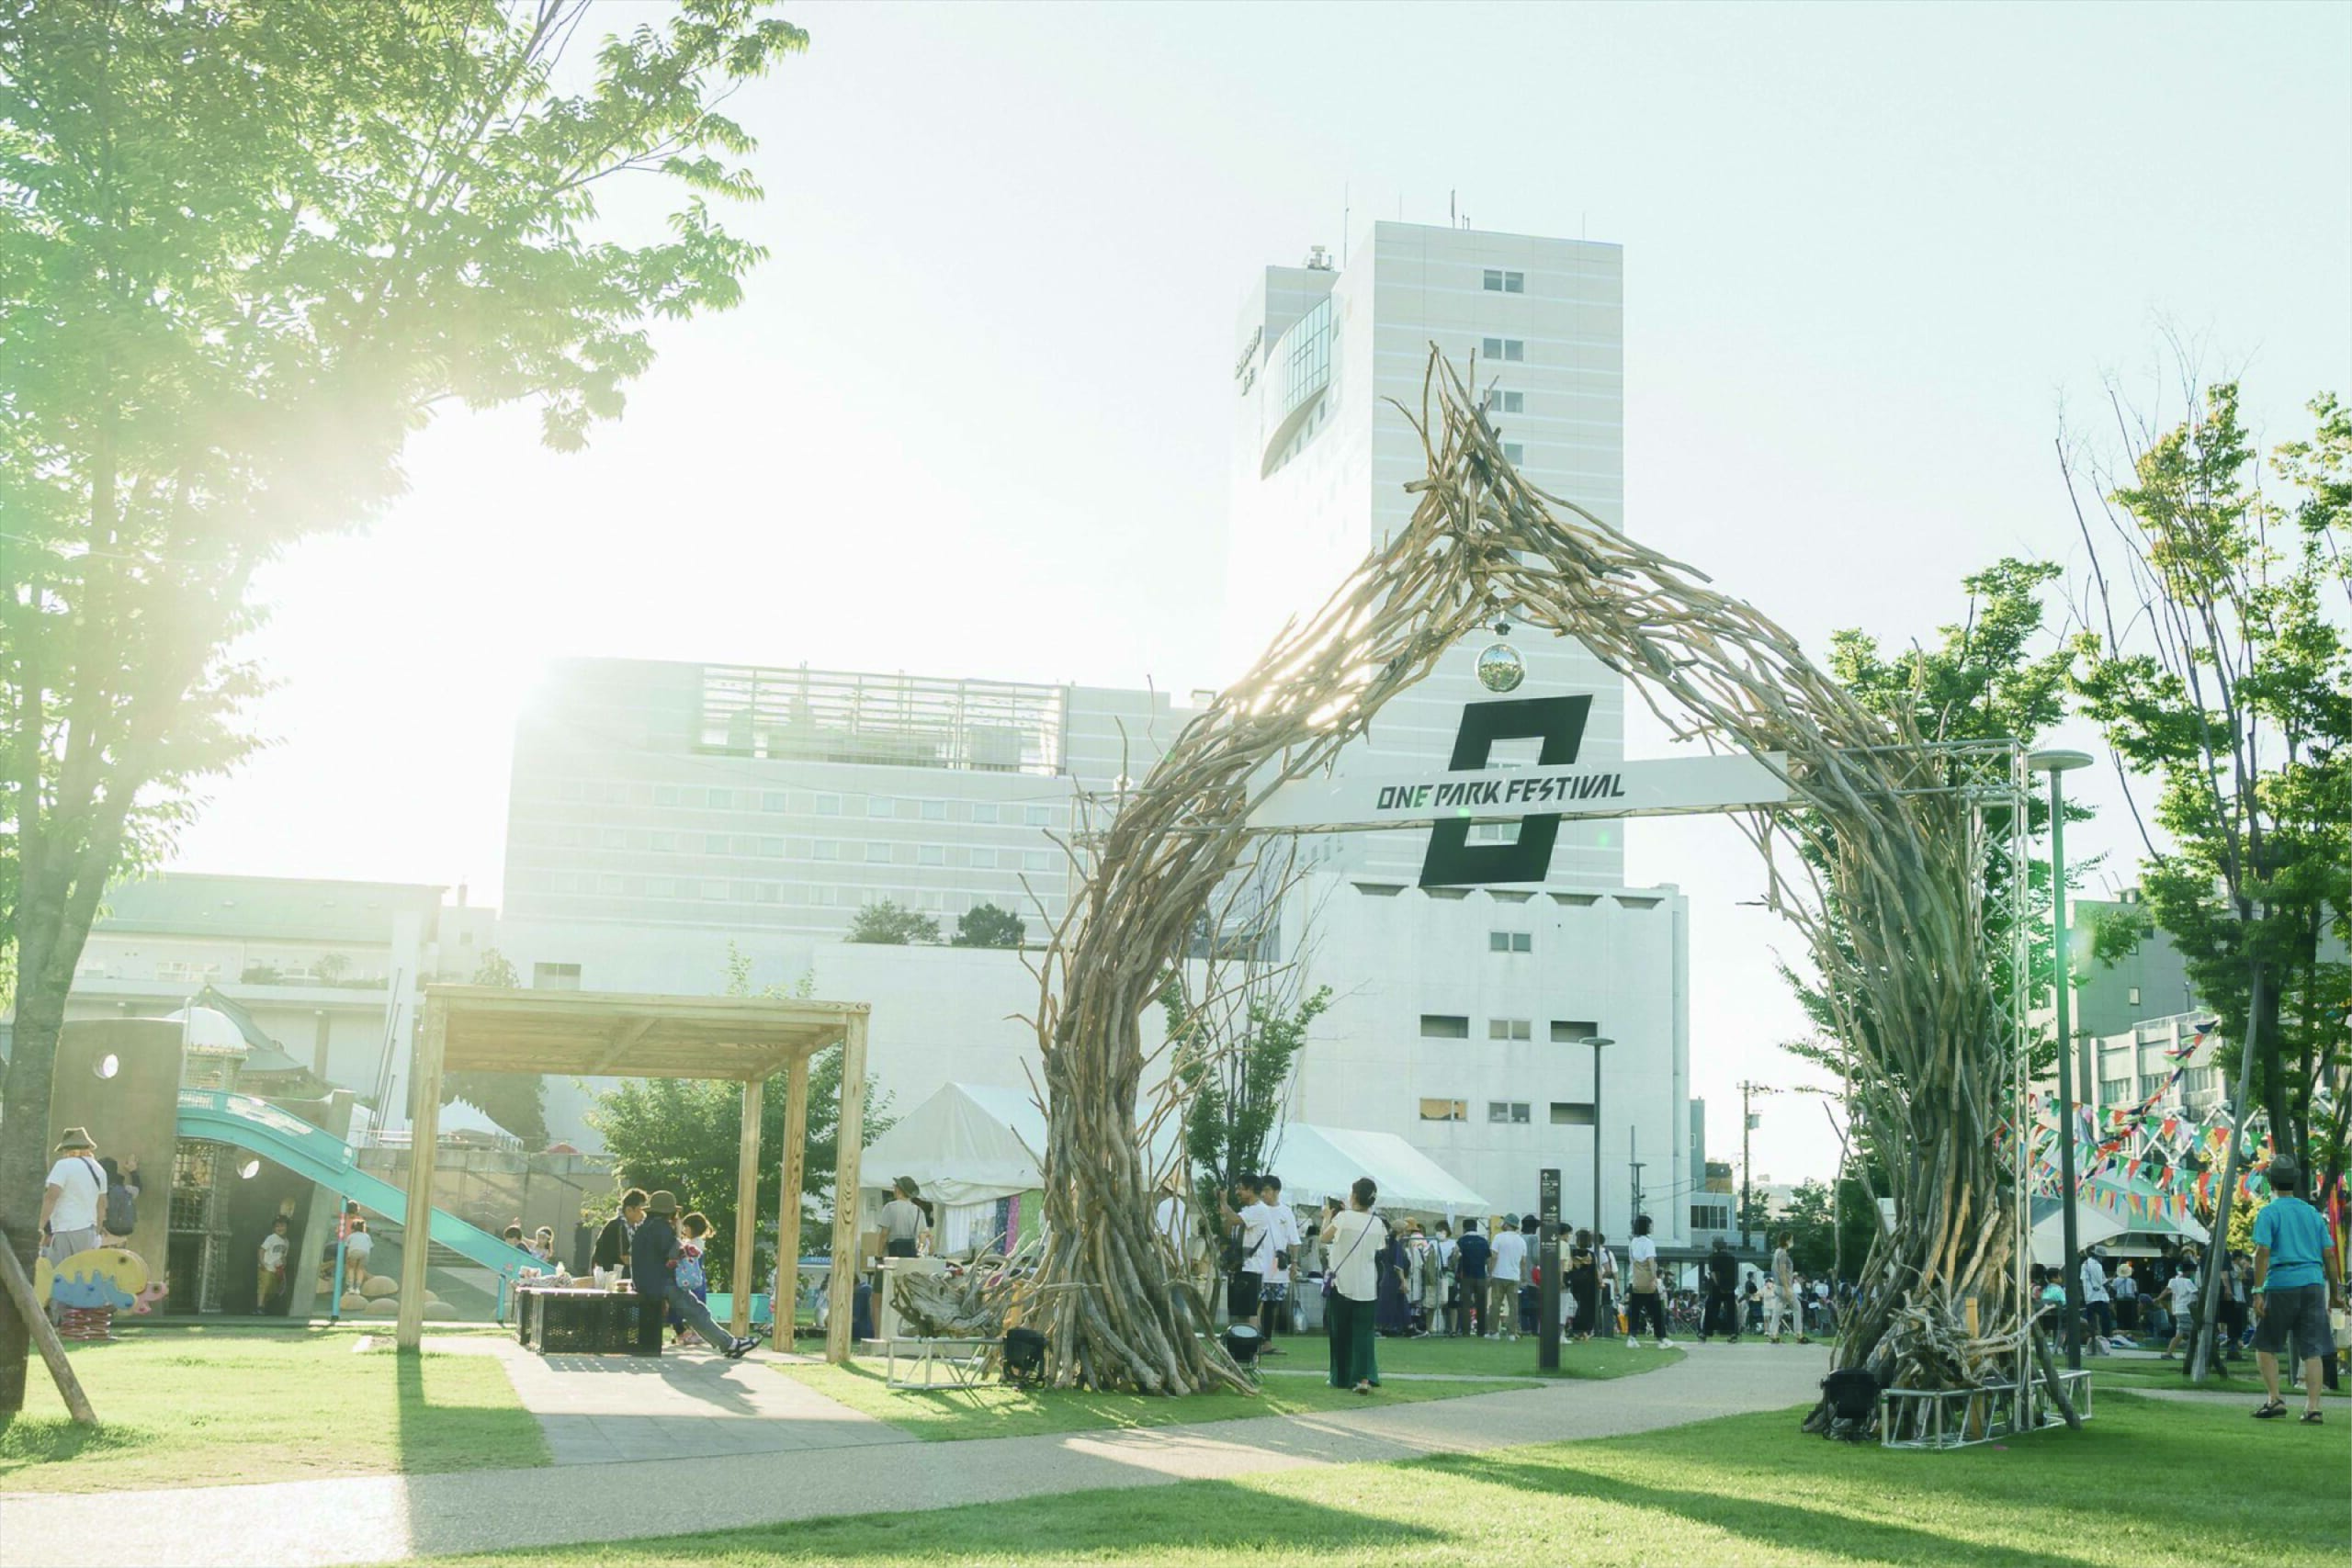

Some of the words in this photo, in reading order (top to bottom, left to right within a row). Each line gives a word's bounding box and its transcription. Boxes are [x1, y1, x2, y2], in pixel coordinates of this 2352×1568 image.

[1376, 784, 1434, 810] ONE
[1434, 780, 1502, 807] PARK
[1504, 773, 1625, 804] FESTIVAL
